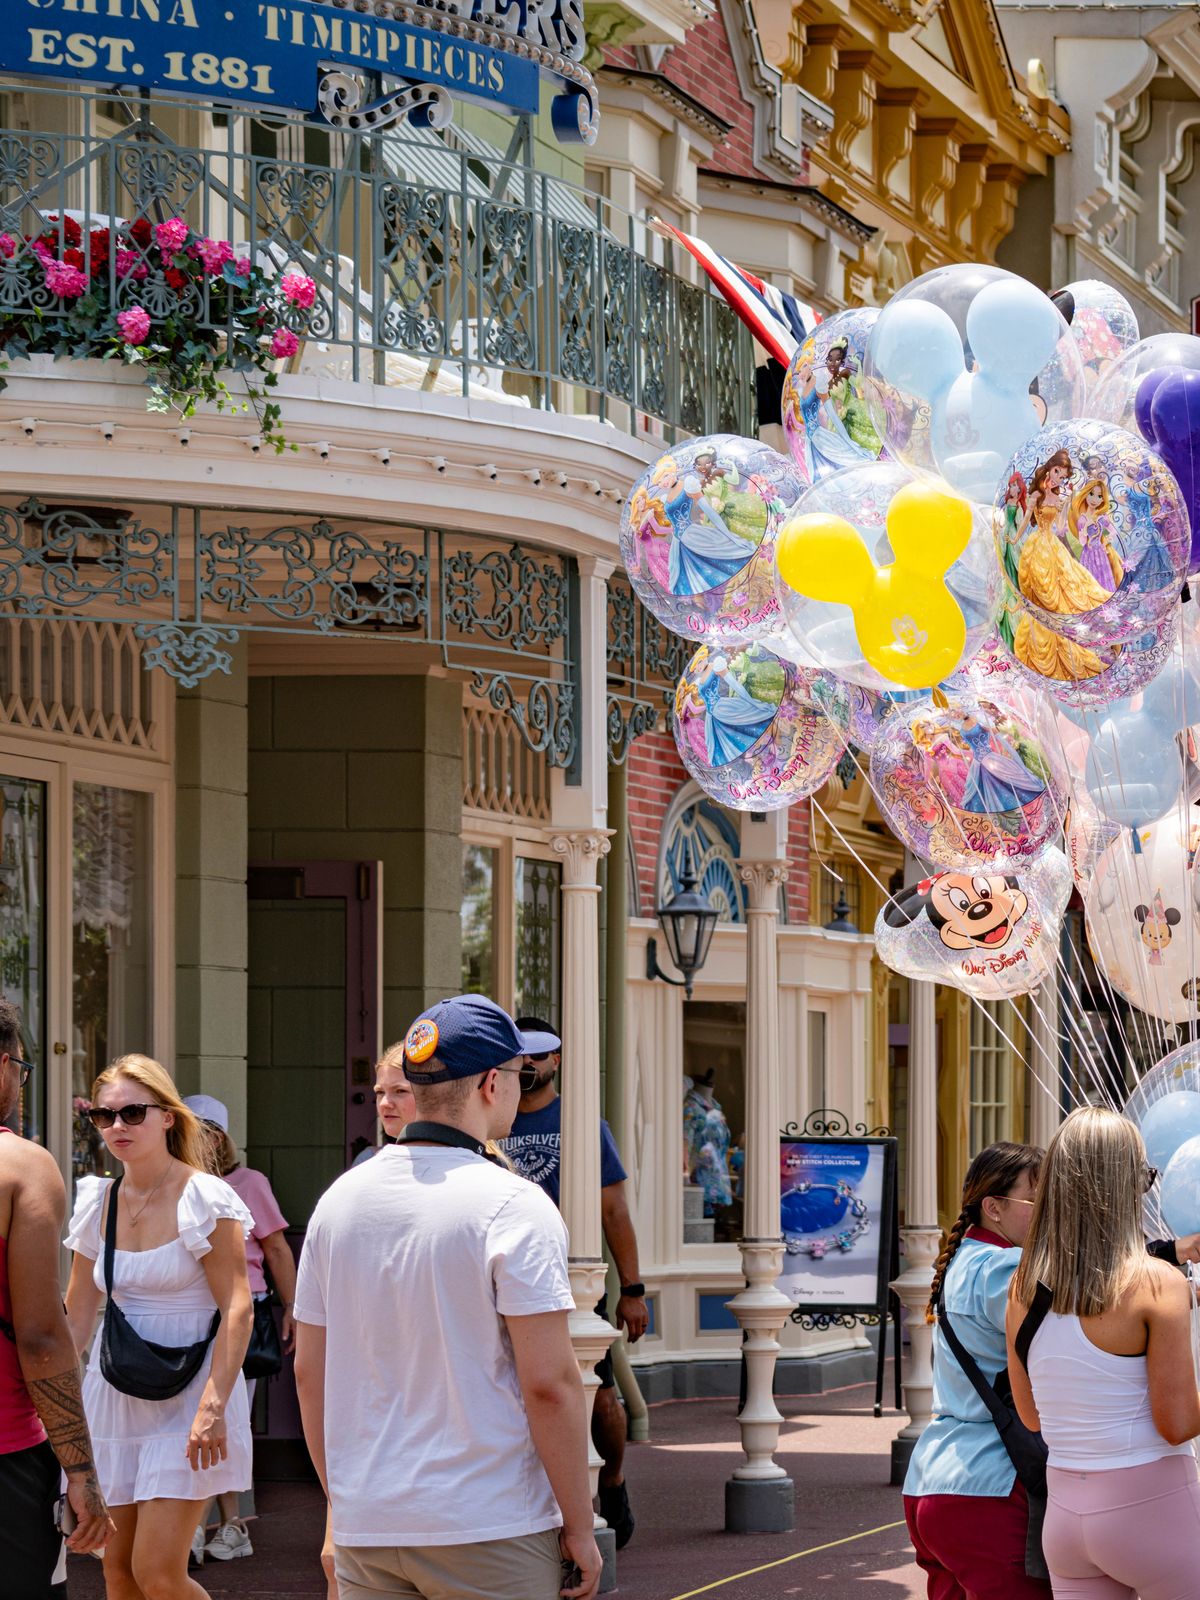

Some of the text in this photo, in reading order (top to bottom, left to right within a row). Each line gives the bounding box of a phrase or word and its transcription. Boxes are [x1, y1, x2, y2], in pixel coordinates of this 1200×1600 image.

[27, 27, 275, 94] EST. 1881
[258, 5, 505, 92] TIMEPIECES
